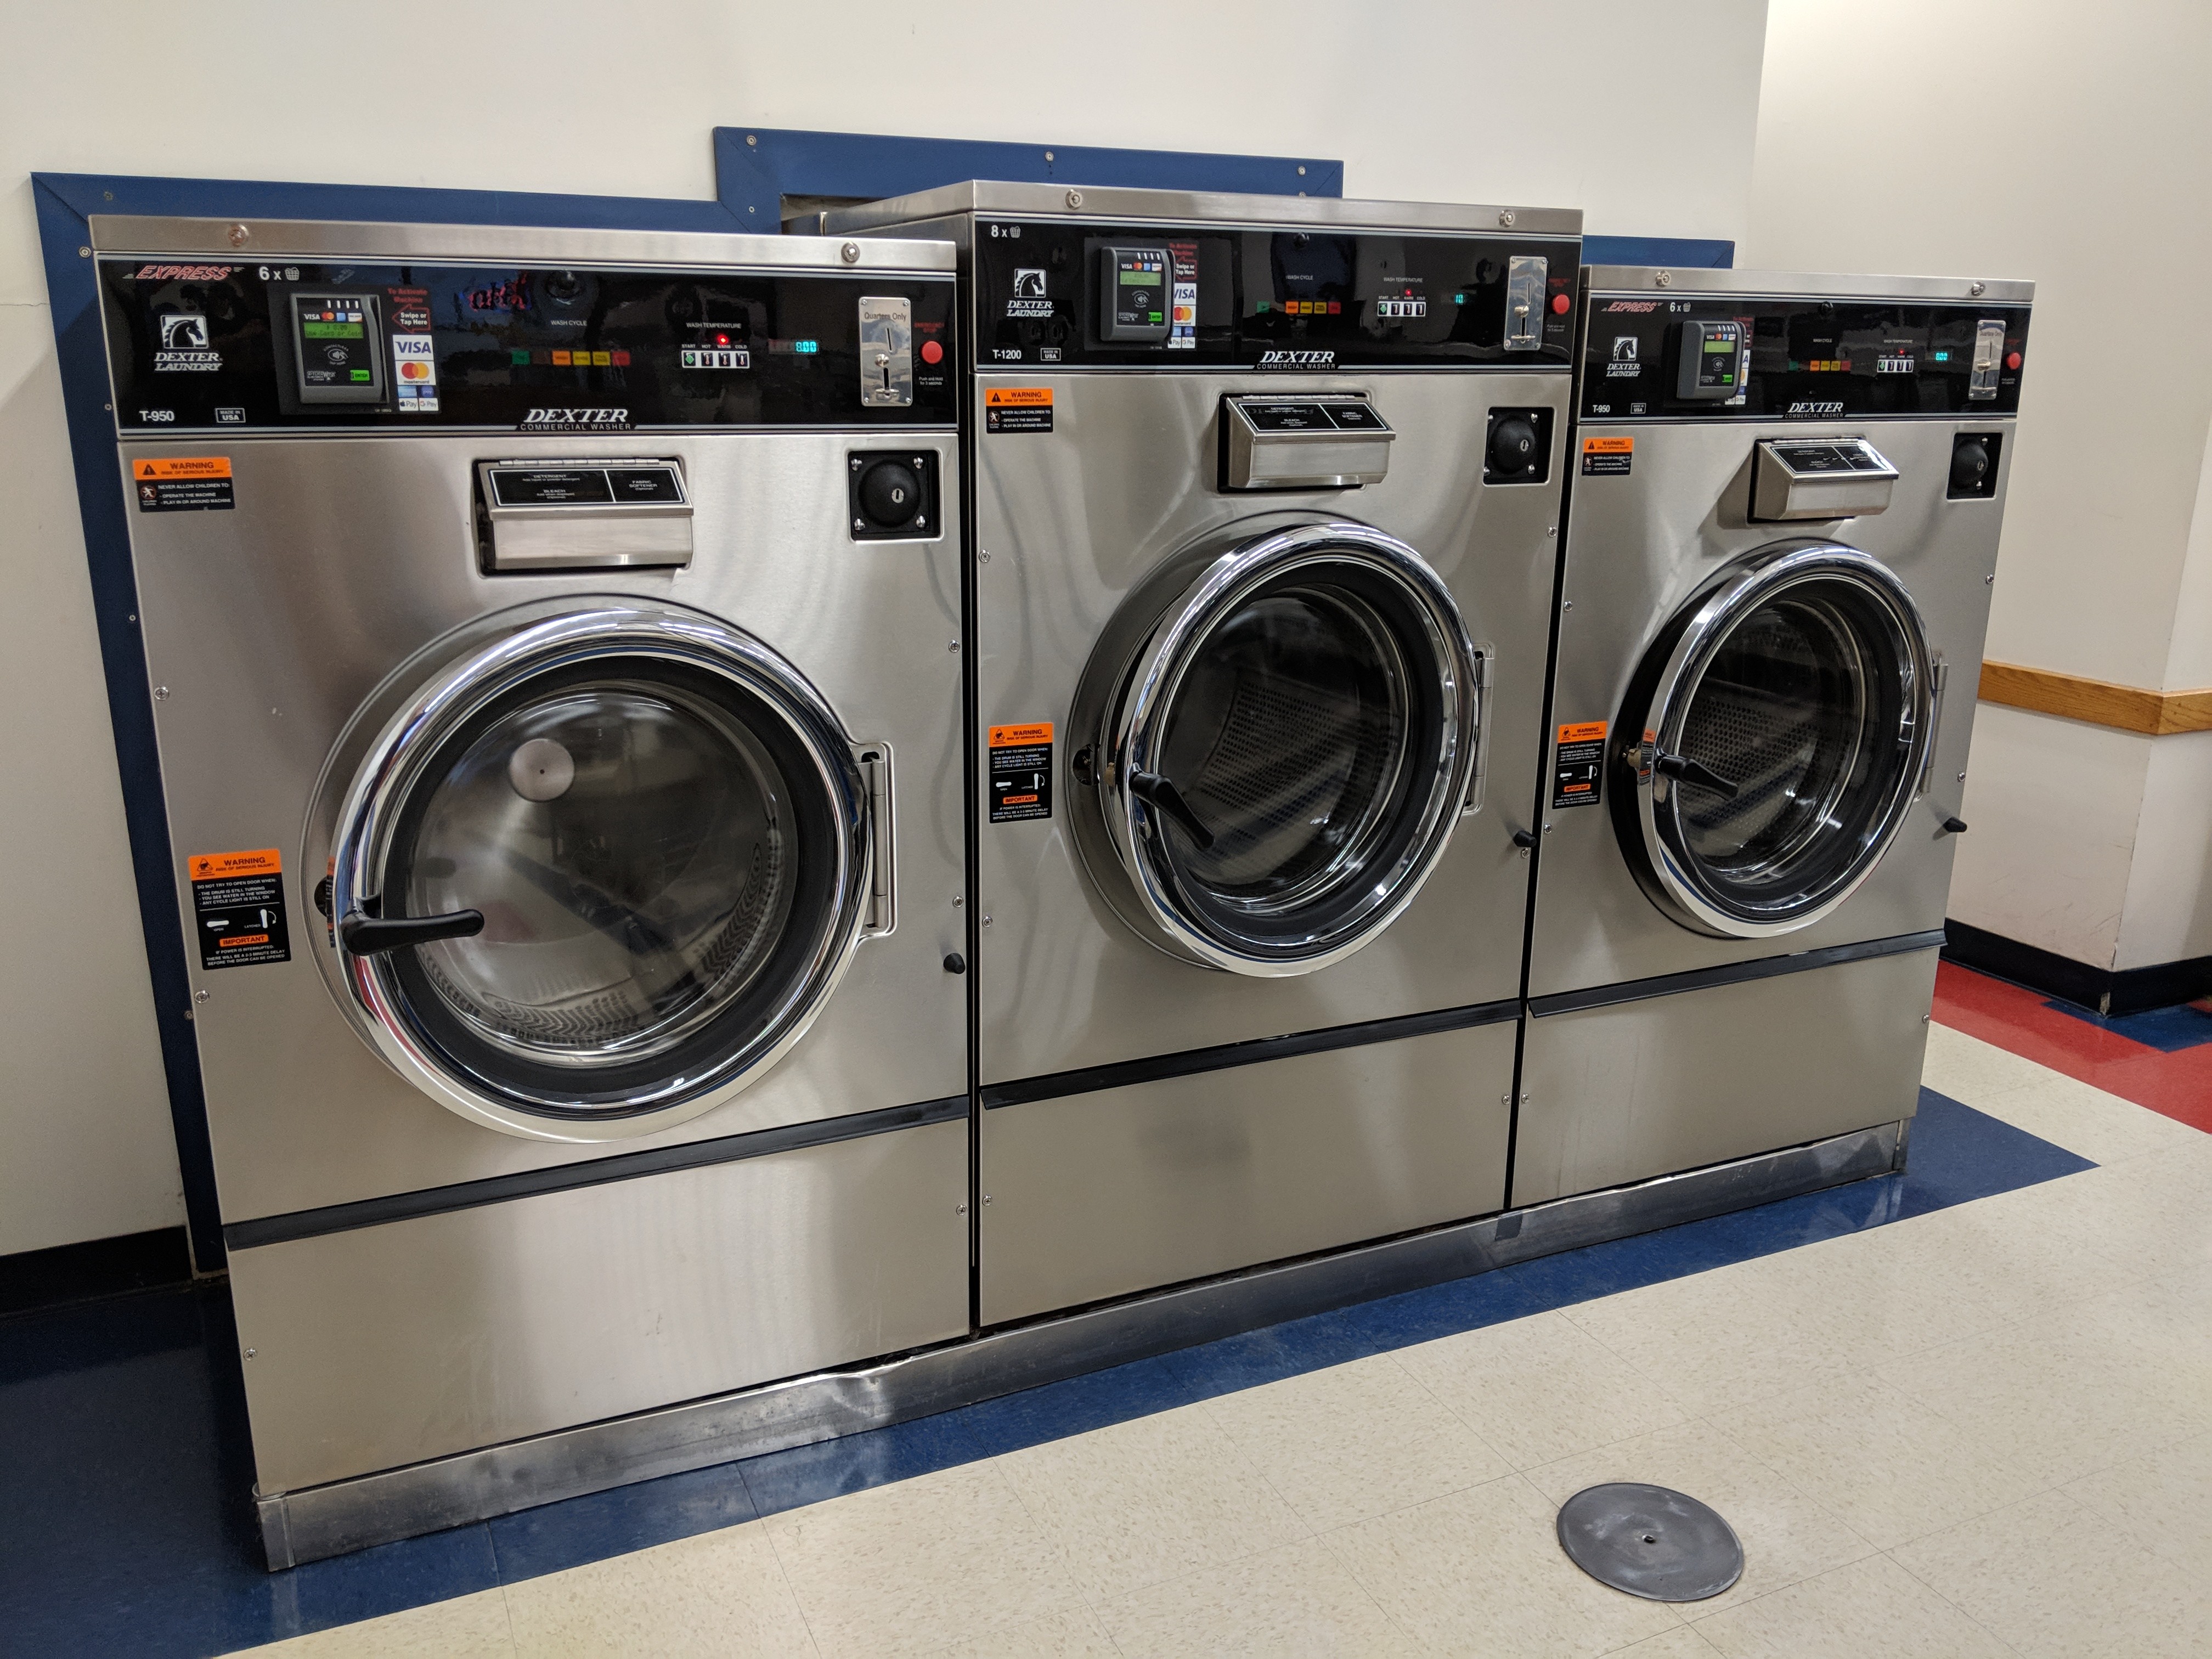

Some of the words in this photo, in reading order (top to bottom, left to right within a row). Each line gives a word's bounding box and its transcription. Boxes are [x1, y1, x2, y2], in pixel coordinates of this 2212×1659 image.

[991, 225, 998, 237] 8
[136, 265, 232, 280] EXPRESS
[259, 267, 269, 280] 6
[1007, 300, 1052, 308] DEXTER
[1607, 302, 1657, 313] EXPRESS
[1669, 302, 1675, 312] 6
[892, 312, 907, 322] Only
[395, 341, 431, 353] VISA
[154, 352, 219, 362] DEXTER
[992, 349, 1022, 359] T-1200
[1260, 351, 1335, 363] DEXTER
[154, 363, 222, 371] LAUNDRY
[1593, 405, 1610, 413] T-950
[1787, 403, 1844, 413] DEXTER
[139, 410, 174, 421] T-950
[523, 409, 628, 422] DEXTER
[170, 461, 214, 470] WARNING
[224, 857, 266, 866] WARNING
[223, 936, 264, 945] IMPORTANT
